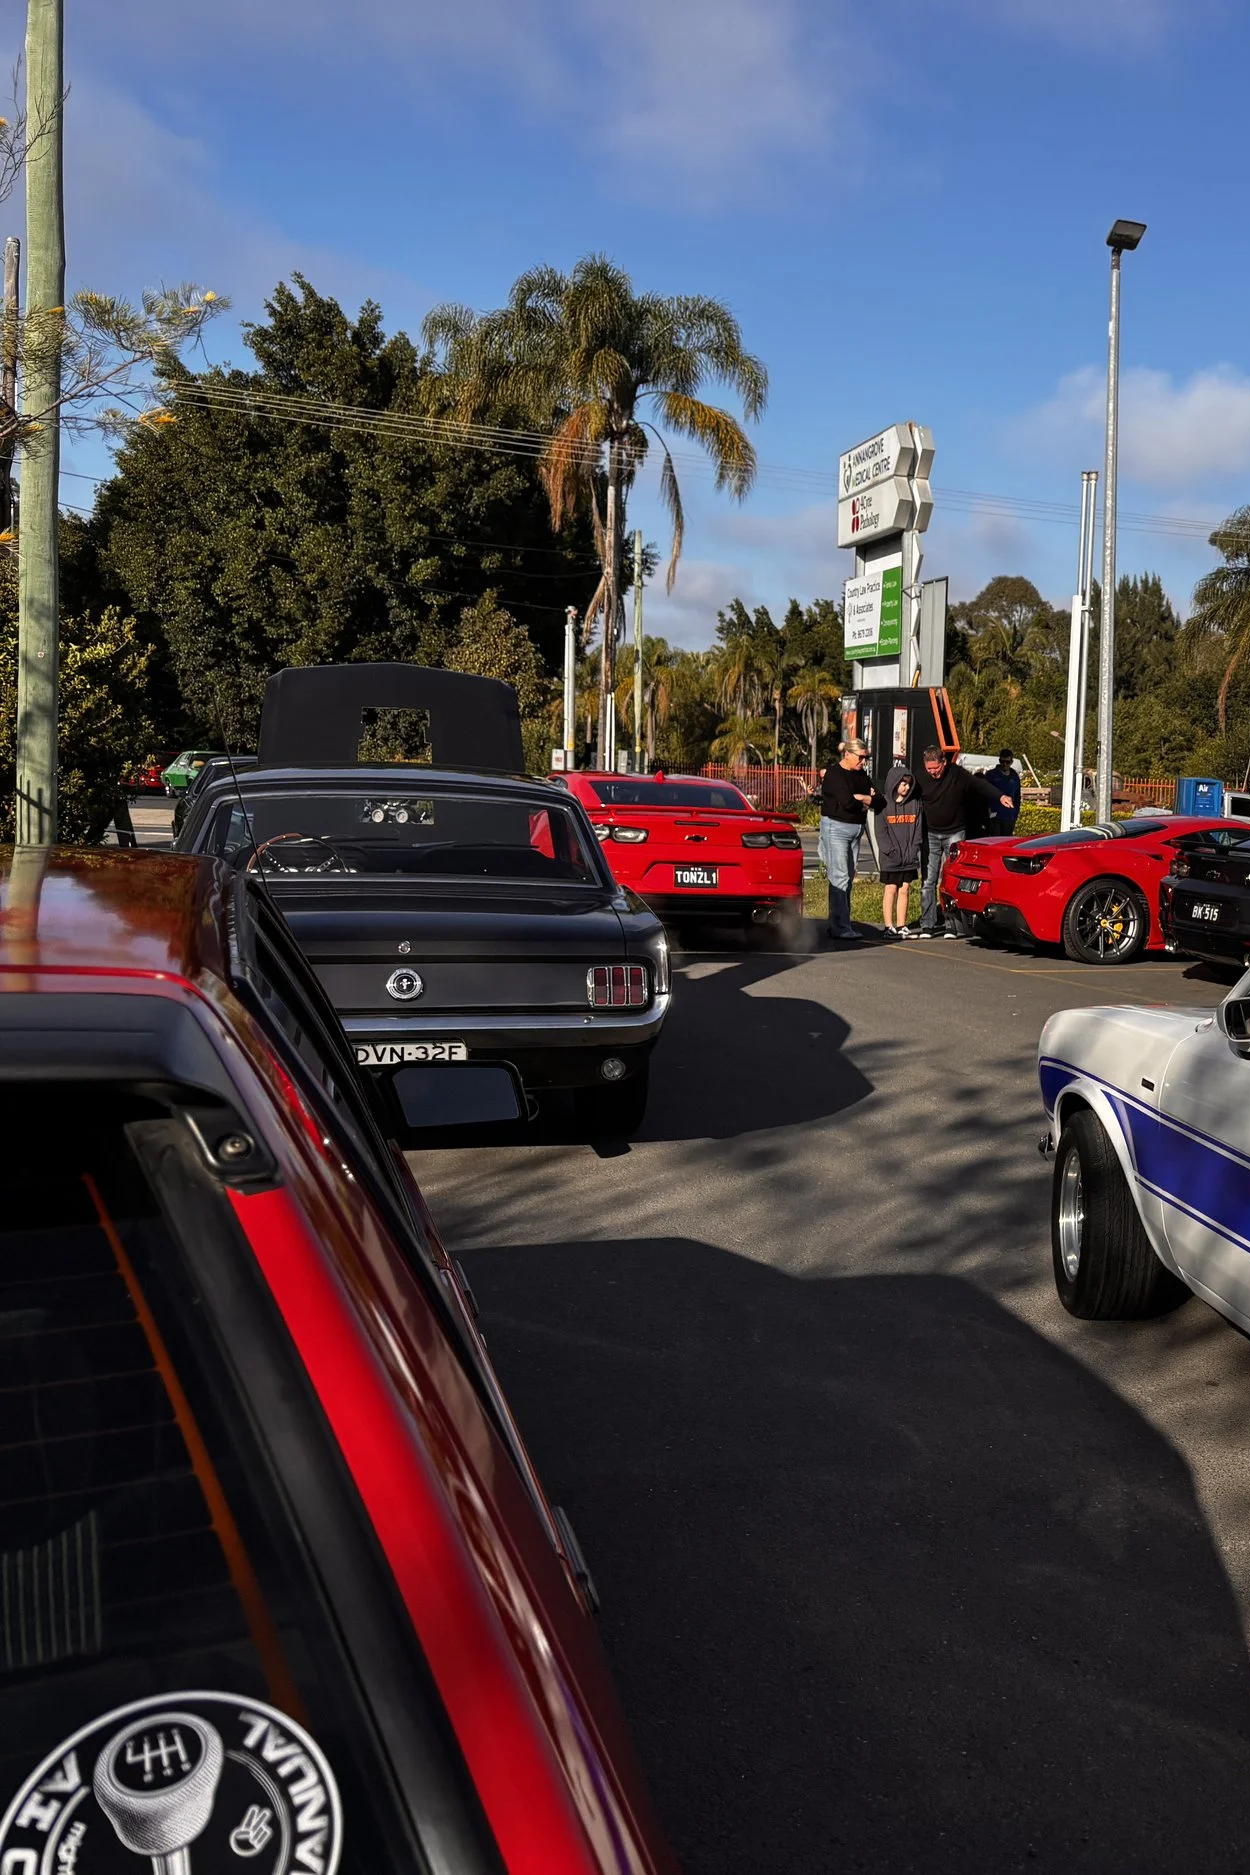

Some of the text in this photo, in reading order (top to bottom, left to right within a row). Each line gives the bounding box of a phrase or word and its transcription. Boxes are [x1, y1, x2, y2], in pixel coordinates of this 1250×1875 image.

[872, 456, 890, 476] CENTRE
[860, 512, 880, 530] Pathology
[1199, 784, 1208, 792] Air
[238, 1711, 329, 1875] ANUAL
